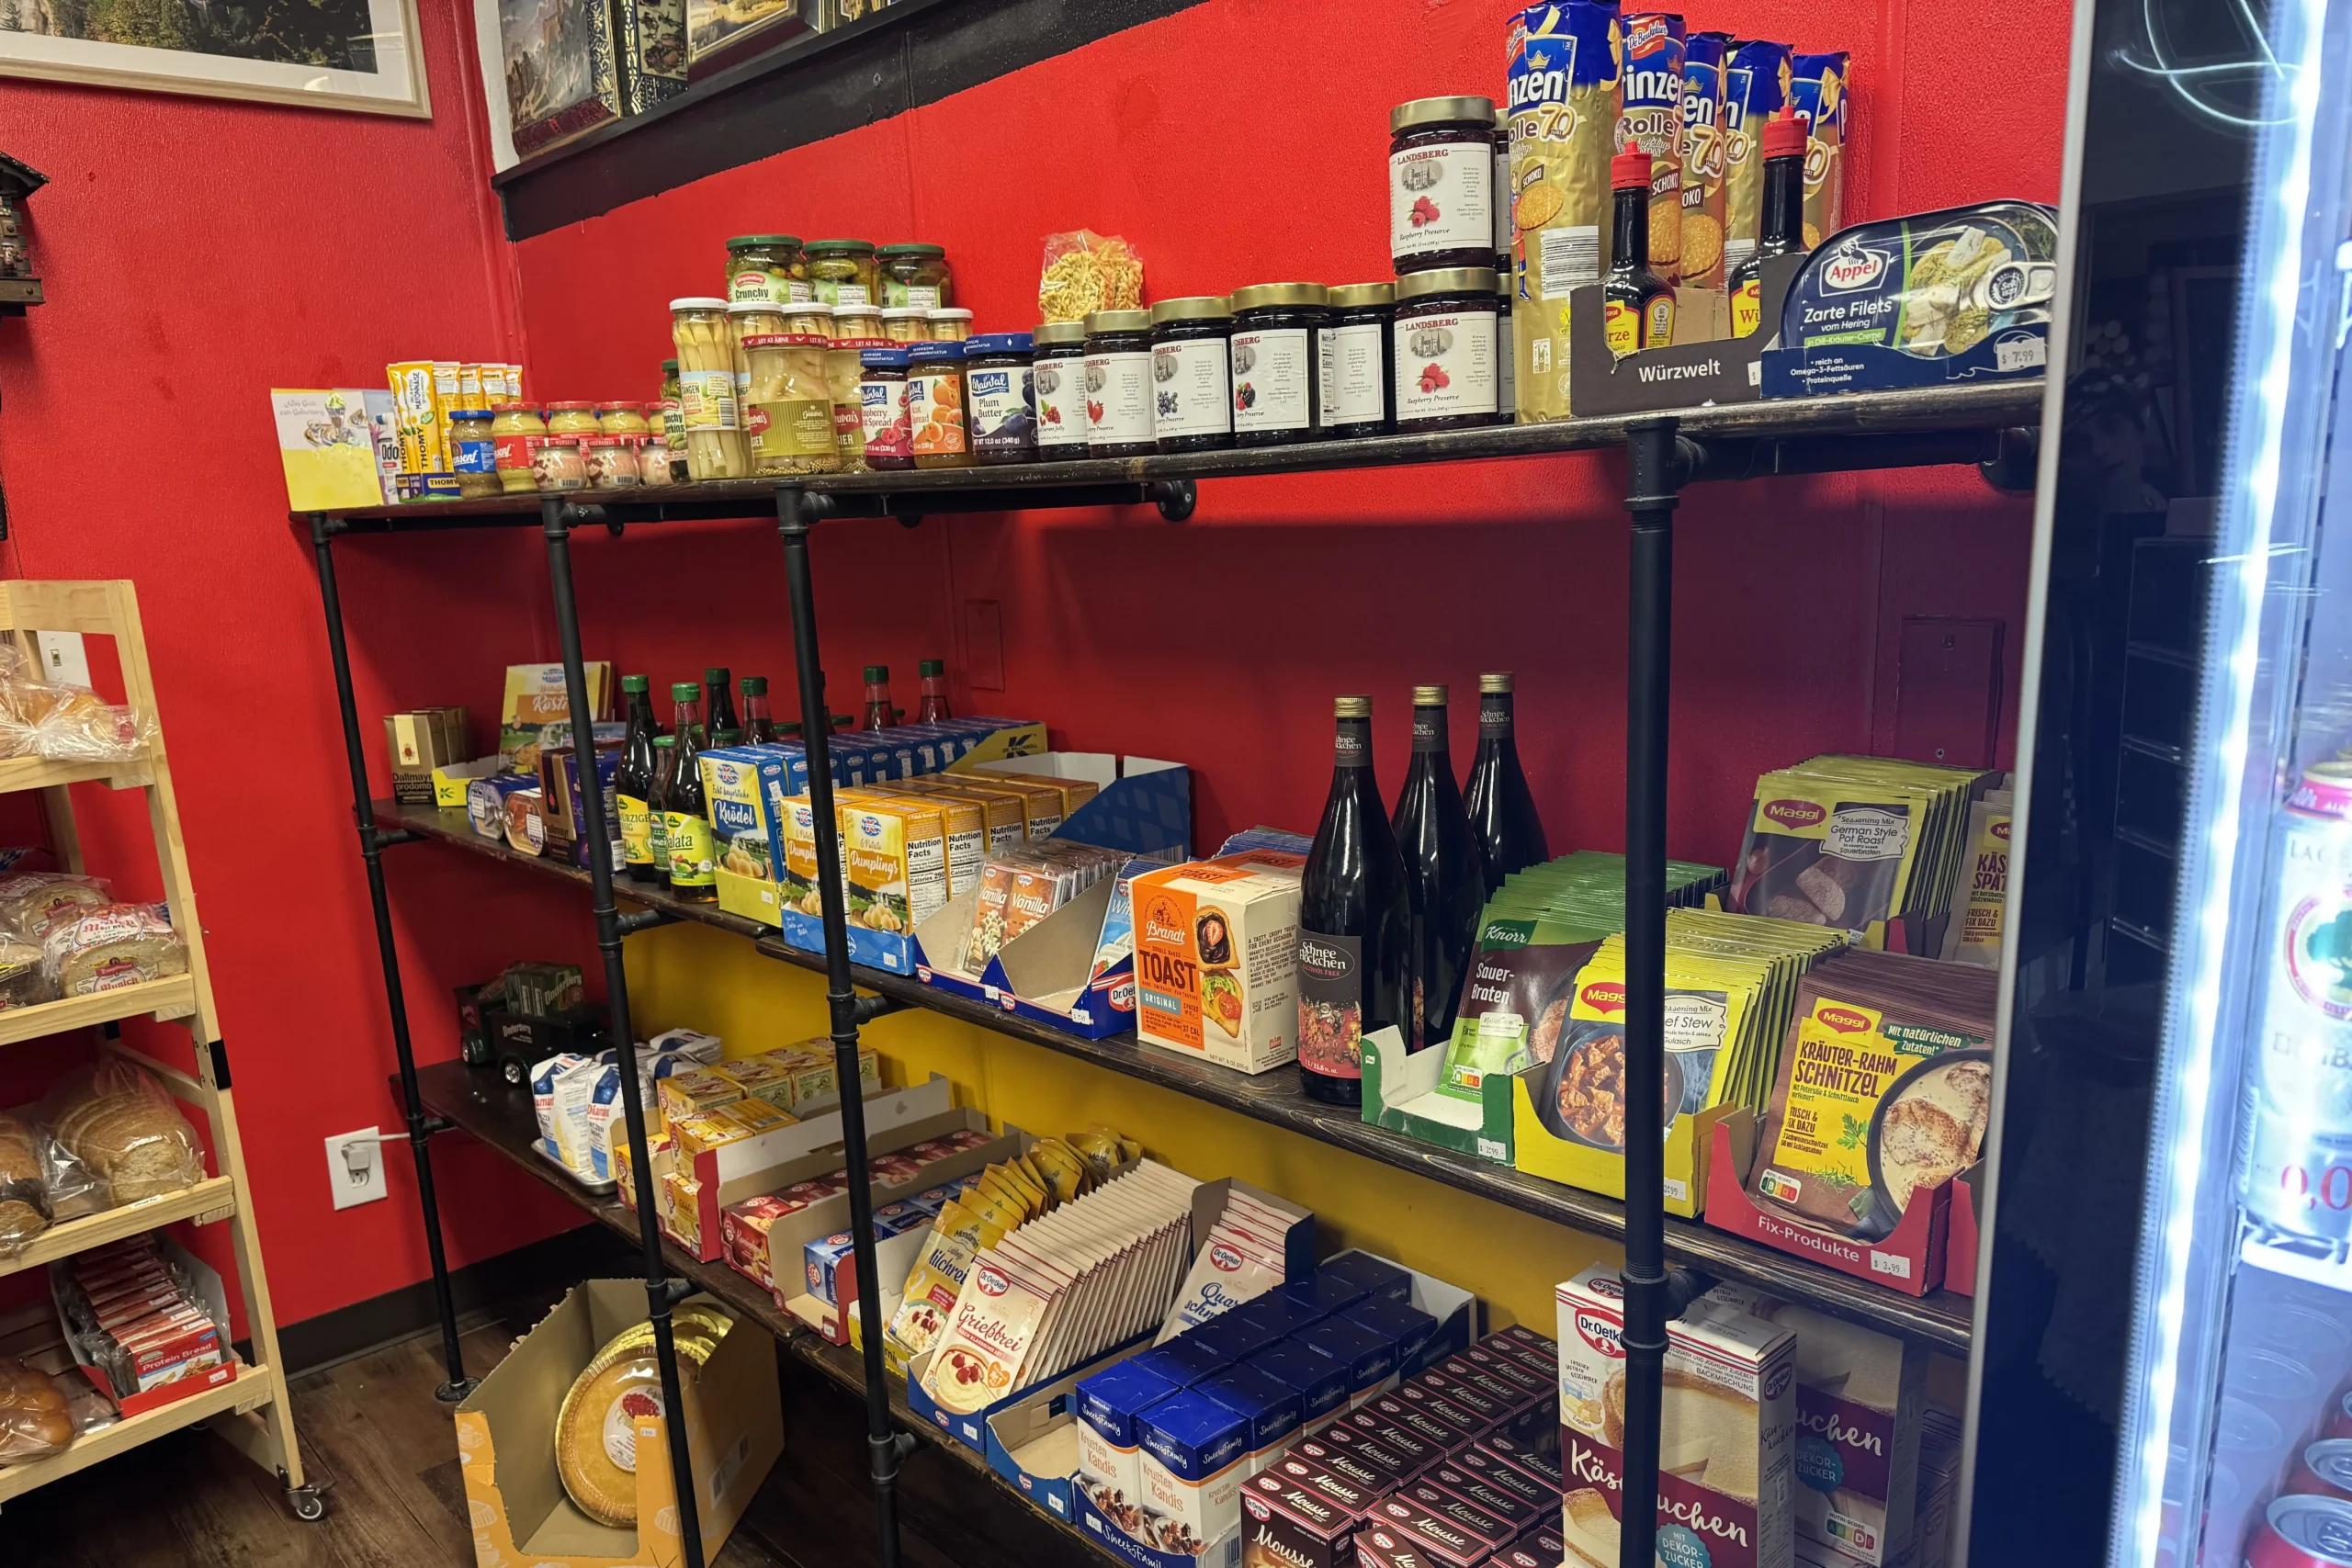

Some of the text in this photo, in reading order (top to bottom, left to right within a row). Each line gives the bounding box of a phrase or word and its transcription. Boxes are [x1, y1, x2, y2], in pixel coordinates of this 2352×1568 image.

[1637, 21, 1668, 43] Beukelaer
[1509, 118, 1538, 142] olle
[1539, 102, 1575, 140] 70
[1622, 113, 1674, 136] Rolle
[1396, 148, 1449, 164] LANDSBERG
[1522, 165, 1543, 186] SCHOKO
[1652, 171, 1679, 195] SCHOKO
[1399, 228, 1450, 242] Raspberry Preserve
[1829, 260, 1878, 281] Appel
[735, 288, 769, 300] Crunchy
[1804, 299, 1893, 324] Zarte Filets
[1405, 317, 1459, 332] LANDSBERG
[1821, 319, 1871, 333] vom Hering
[1815, 332, 1882, 345] Dill-Kräuter-Creme
[1639, 358, 1721, 383] Würzwelt
[1790, 364, 1864, 377] Omega-3-Fettsäuren
[1806, 374, 1852, 385] Proteinquelle
[681, 384, 700, 395] TANGEN
[1408, 393, 1460, 405] Raspberry Preserve
[978, 398, 1000, 408] Plum
[978, 409, 1003, 418] Butter
[415, 427, 428, 469] THOMY
[430, 478, 459, 488] THOMY
[1481, 709, 1506, 719] Schnee
[392, 773, 432, 783] Dallmayr
[395, 783, 432, 791] prodomo
[714, 800, 755, 826] Knödel
[1030, 817, 1060, 827] Nutrition
[1770, 805, 1821, 821] Maggi
[1841, 816, 1880, 825] Seasoning
[948, 831, 981, 843] Nutrition
[990, 825, 1022, 835] Nutrition
[990, 834, 1012, 844] Facts
[1030, 826, 1051, 836] Facts
[1830, 825, 1898, 838] German Style
[1838, 834, 1885, 845] Pot Roast
[866, 840, 882, 851] Potato
[907, 839, 942, 851] Nutrition
[908, 850, 931, 859] Facts
[949, 842, 971, 852] Facts
[1839, 847, 1882, 856] Sauerbraten
[850, 849, 899, 881] Dumplings
[910, 875, 933, 884] Calories
[979, 886, 1008, 905] Vanilla
[1012, 891, 1050, 914] Vanilla
[1965, 918, 1996, 927] FIX DAZU
[1967, 908, 1998, 919] FRISCH &
[1146, 920, 1186, 943] Brandt
[1485, 925, 1528, 944] Knorr
[1301, 941, 1338, 959] Schnee
[1139, 949, 1197, 993] TOAST
[1476, 962, 1515, 982] Sauer-
[1145, 993, 1177, 1010] ORIGINAL
[1471, 983, 1510, 1004] Braten
[1665, 1016, 1713, 1029] ef Stew
[1823, 1012, 1866, 1029] Maggi
[1191, 1026, 1200, 1037] CAL
[1887, 1024, 1962, 1048] Mit natürlichen
[1799, 1040, 1898, 1077] KRÄUTER-RAHM
[1794, 1060, 1880, 1099] SCHNITZEL
[1789, 1106, 1818, 1122] FRISCH &
[1796, 1119, 1815, 1134] DAZU
[1766, 1170, 1793, 1185] NUTRI-SCORE
[954, 1229, 979, 1249] Mondamin
[1758, 1215, 1860, 1263] Fix-Produkte
[929, 1247, 969, 1286] ilchrei
[1213, 1247, 1241, 1267] Dr.Oetker
[1883, 1260, 1901, 1273] 3.99
[979, 1270, 1008, 1292] Dr.Oetker
[957, 1302, 1023, 1353] Grießbrei
[1580, 1314, 1624, 1342] Dr.Oetk
[142, 1342, 212, 1371] Protein Bread
[1511, 1351, 1558, 1373] Mousse
[1692, 1353, 1705, 1363] UND
[1704, 1357, 1729, 1373] JOGHURT
[1729, 1366, 1755, 1381] ZUGEBEN
[1695, 1366, 1755, 1393] BACKMISCHUNG
[1765, 1369, 1792, 1393] Dr.Oetker
[1446, 1386, 1493, 1410] Mousse
[1401, 1413, 1450, 1438] Mousse
[1080, 1429, 1108, 1459] Krusten
[1375, 1427, 1425, 1452] Mousse
[1087, 1449, 1117, 1478] Kandis
[1326, 1456, 1376, 1481] Mousse
[1514, 1452, 1563, 1481] Mousse
[1797, 1461, 1838, 1483] ZUCKER
[1142, 1461, 1173, 1490] Krusten
[1151, 1481, 1183, 1512] Kandis
[1308, 1474, 1360, 1500] Mousse
[1462, 1484, 1516, 1510] Mousse
[1281, 1490, 1331, 1518] Mousse
[1440, 1502, 1494, 1529] Mousse
[1828, 1512, 1867, 1531] NUTRI-SCORE
[1410, 1518, 1465, 1546] Mousse
[1672, 1531, 1687, 1541] MIT
[1252, 1524, 1317, 1568] Mousse
[1661, 1538, 1704, 1558] DEKOR-
[1665, 1552, 1705, 1568] ZUCKER
